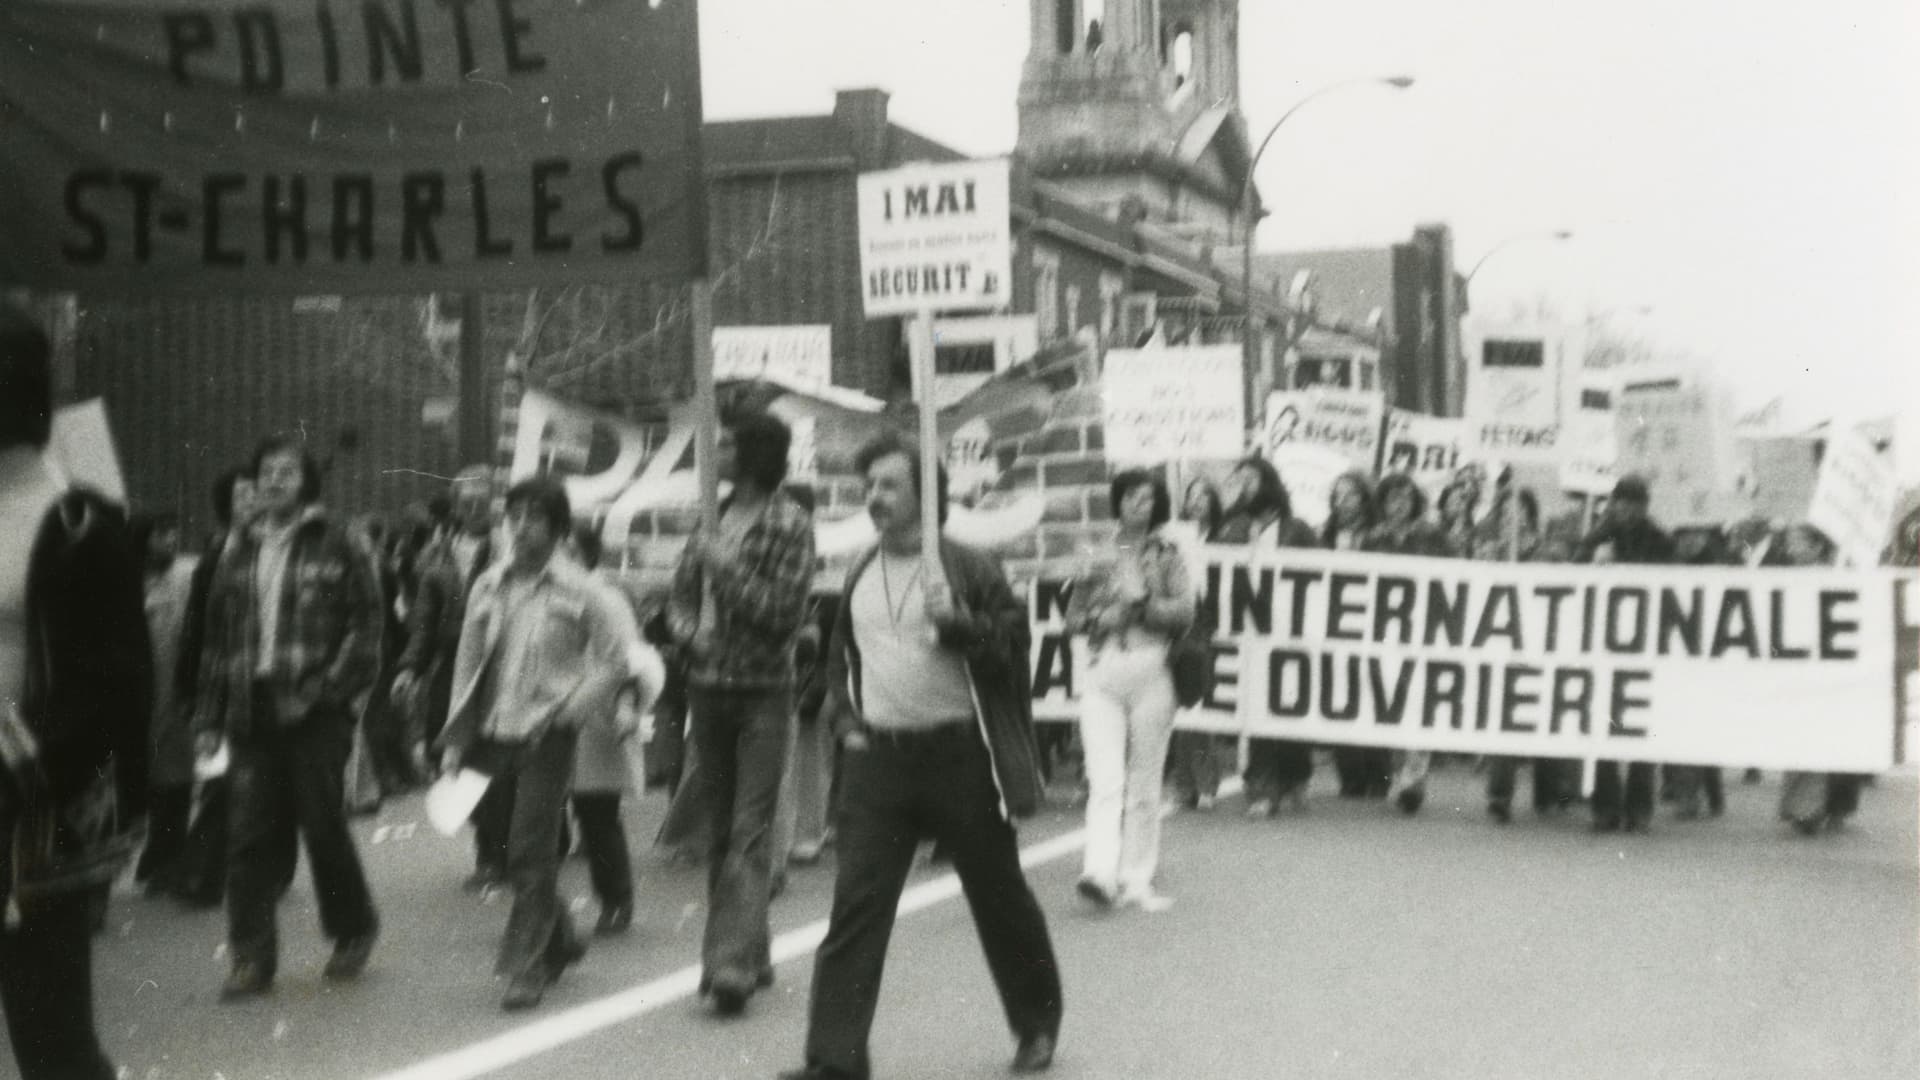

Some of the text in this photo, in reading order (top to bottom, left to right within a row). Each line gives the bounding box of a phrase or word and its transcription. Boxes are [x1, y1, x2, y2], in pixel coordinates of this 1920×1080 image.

[60, 149, 643, 266] ST-CHARLES
[905, 180, 975, 217] MAI
[1206, 563, 1859, 662] INTERNATIONALE
